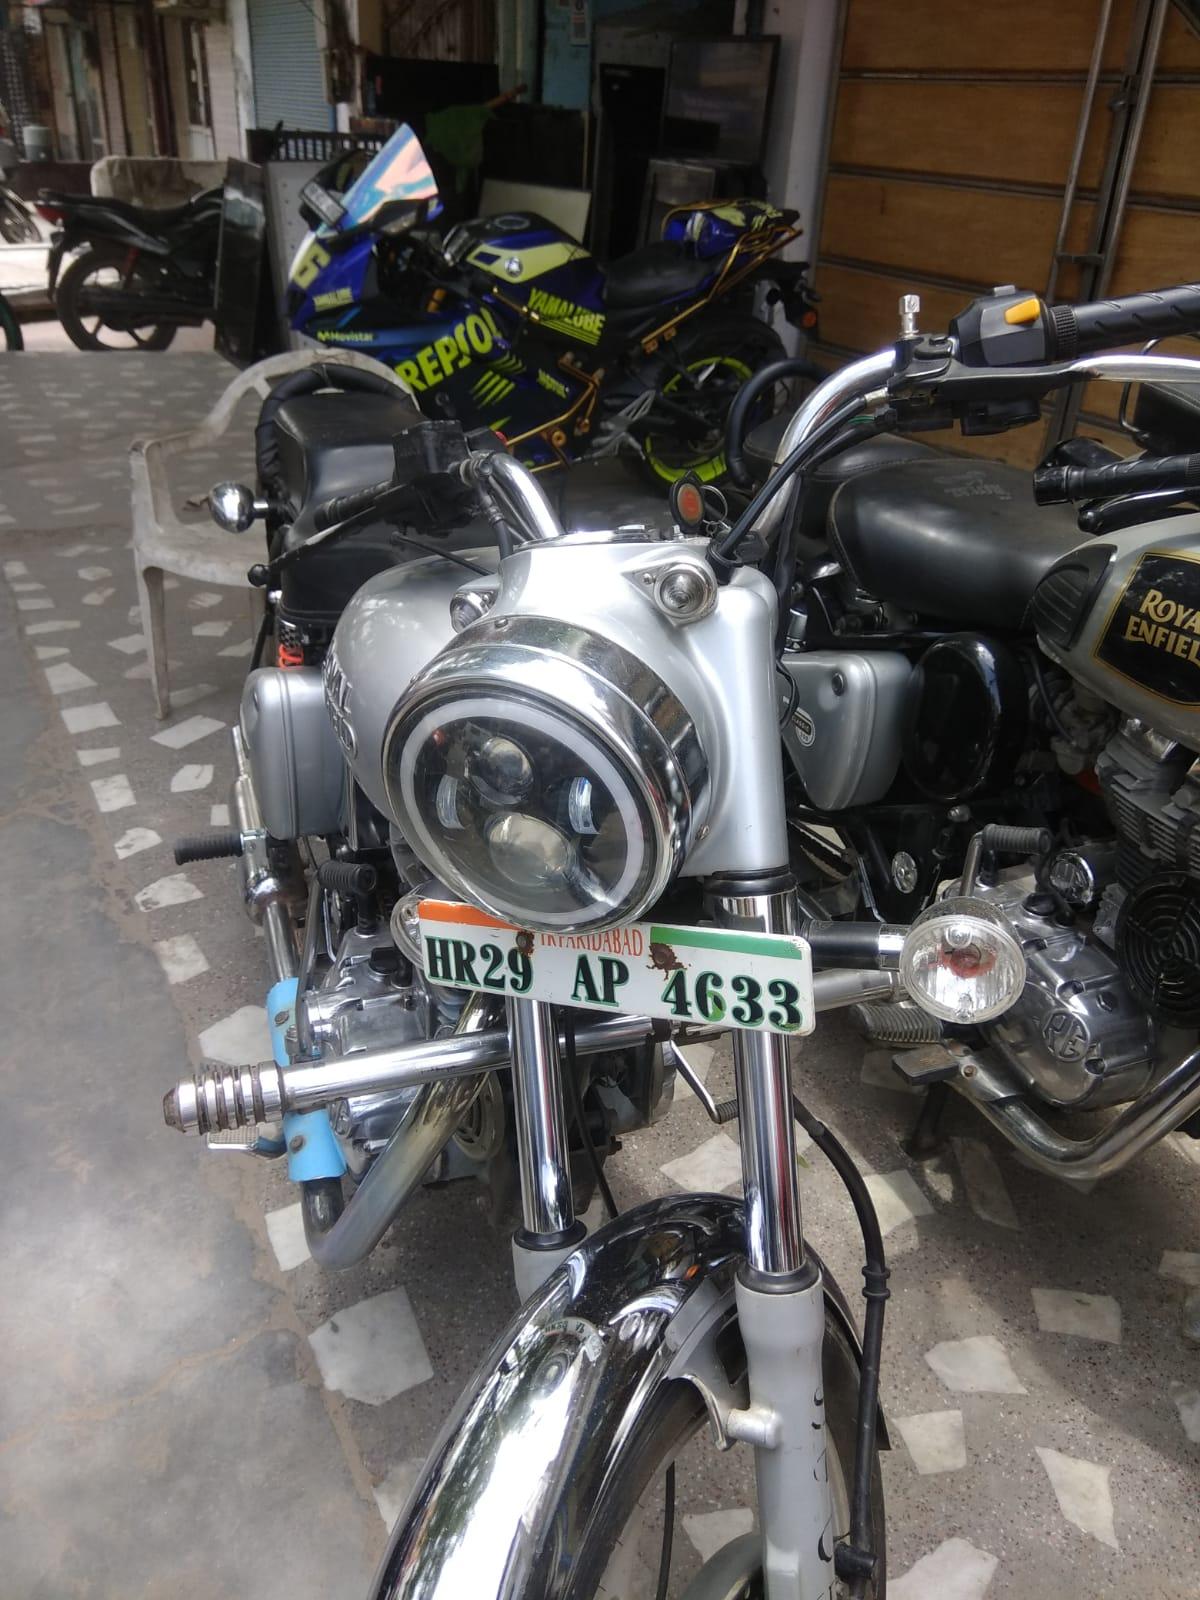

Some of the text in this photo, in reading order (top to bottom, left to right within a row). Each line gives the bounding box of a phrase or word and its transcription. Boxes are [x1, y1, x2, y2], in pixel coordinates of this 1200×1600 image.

[425, 935, 803, 1032] HR29 AP 4633
